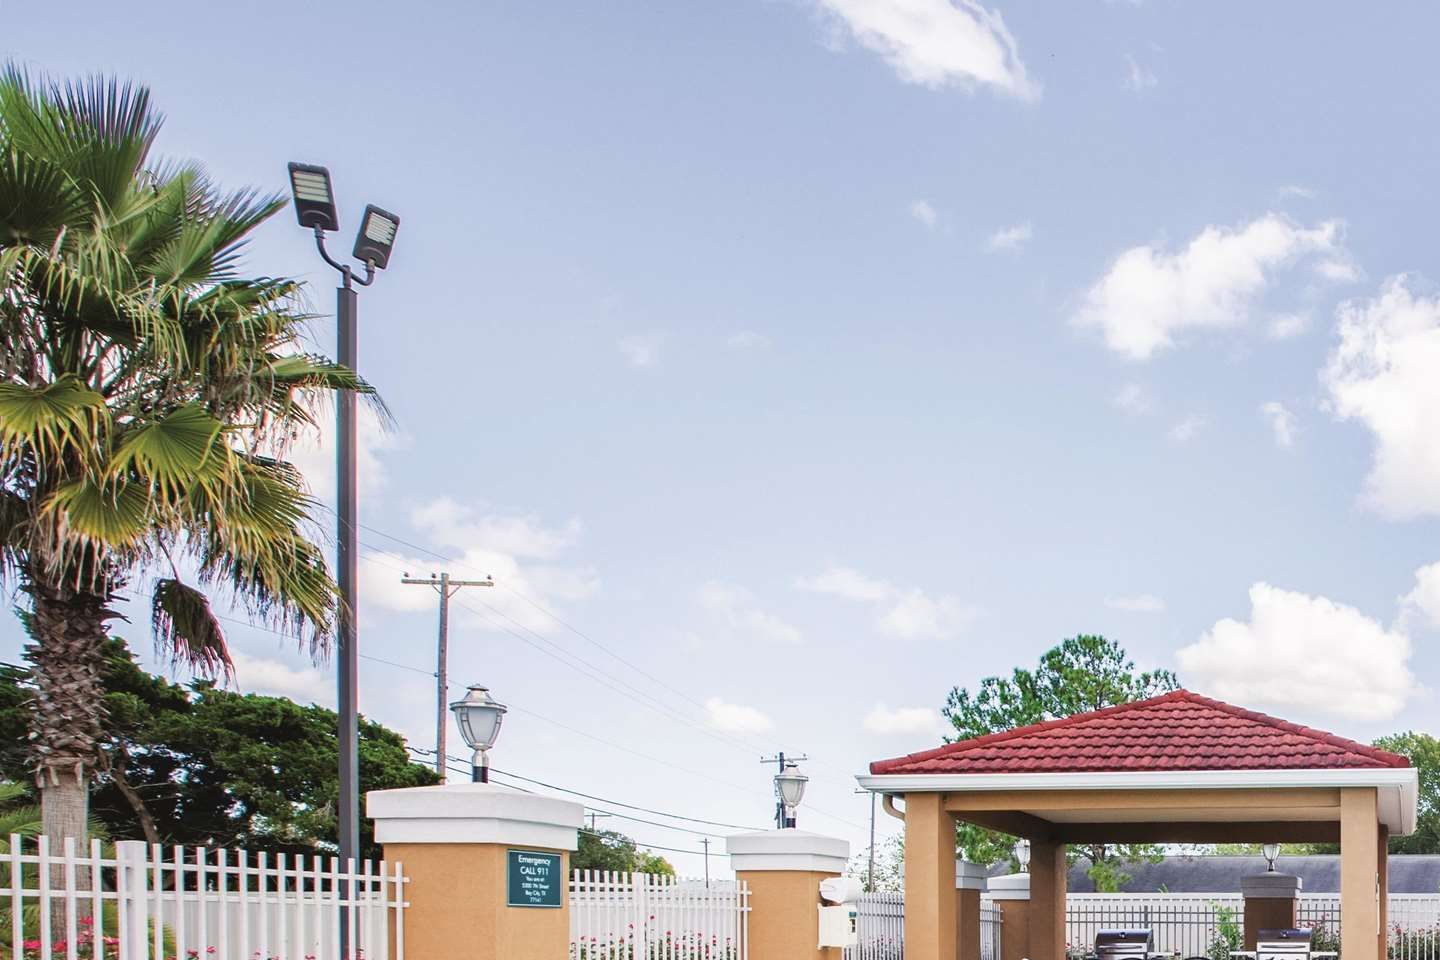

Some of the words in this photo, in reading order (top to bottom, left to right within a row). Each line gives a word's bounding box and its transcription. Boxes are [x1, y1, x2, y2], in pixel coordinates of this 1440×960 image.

[518, 855, 551, 867] Emergency
[520, 866, 536, 875] CALL
[537, 867, 548, 876] 911
